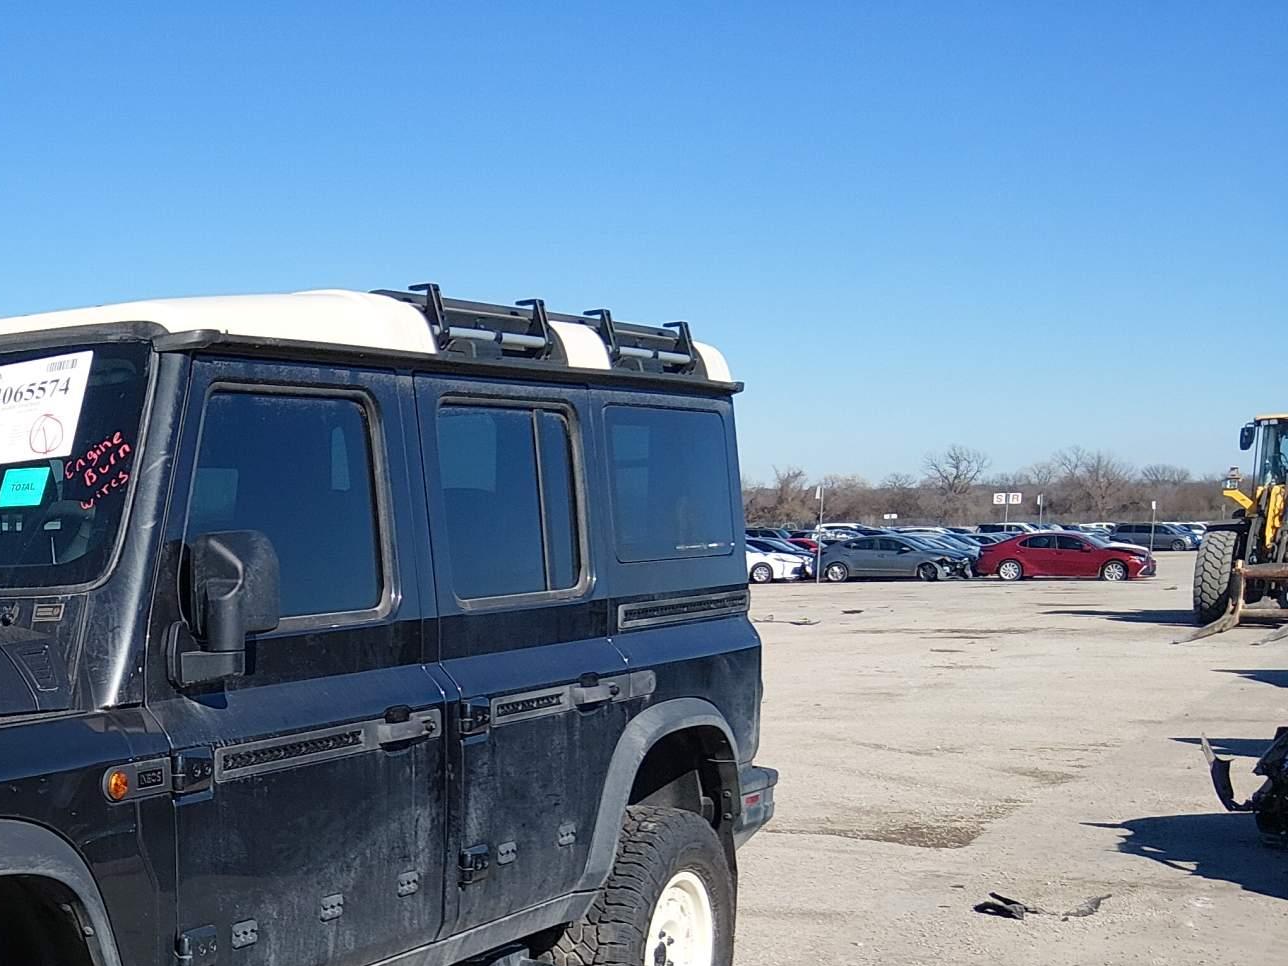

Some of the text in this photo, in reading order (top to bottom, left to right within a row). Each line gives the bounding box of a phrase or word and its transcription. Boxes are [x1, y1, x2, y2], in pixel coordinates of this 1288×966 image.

[64, 431, 123, 479] Engine
[84, 443, 131, 486] Burn
[10, 482, 35, 492] TOTAL
[996, 495, 1003, 503] S
[139, 770, 162, 785] INEOS
